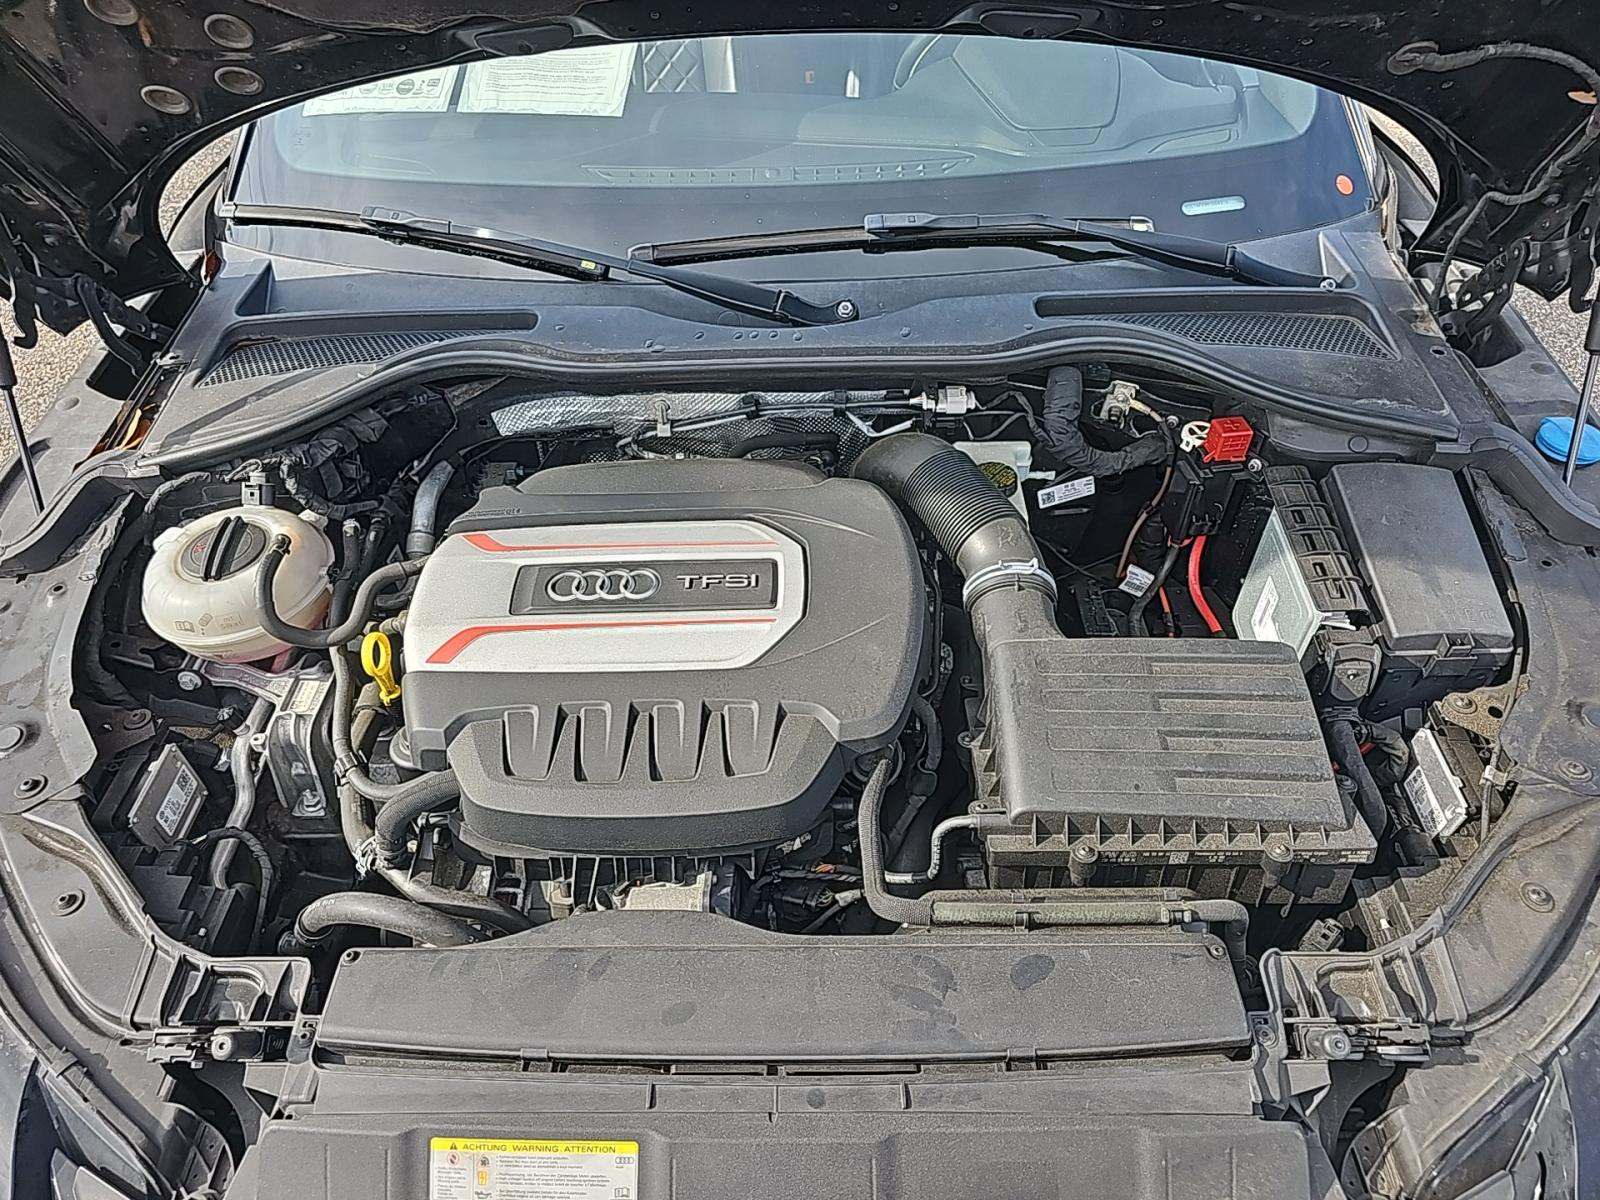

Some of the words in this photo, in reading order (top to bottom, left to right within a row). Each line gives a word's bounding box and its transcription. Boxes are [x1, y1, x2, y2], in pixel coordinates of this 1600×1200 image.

[676, 574, 759, 589] TFSI
[462, 1143, 507, 1152] ACHTUNG
[512, 1145, 559, 1153] WARNING
[564, 1145, 616, 1154] ATTENTION
